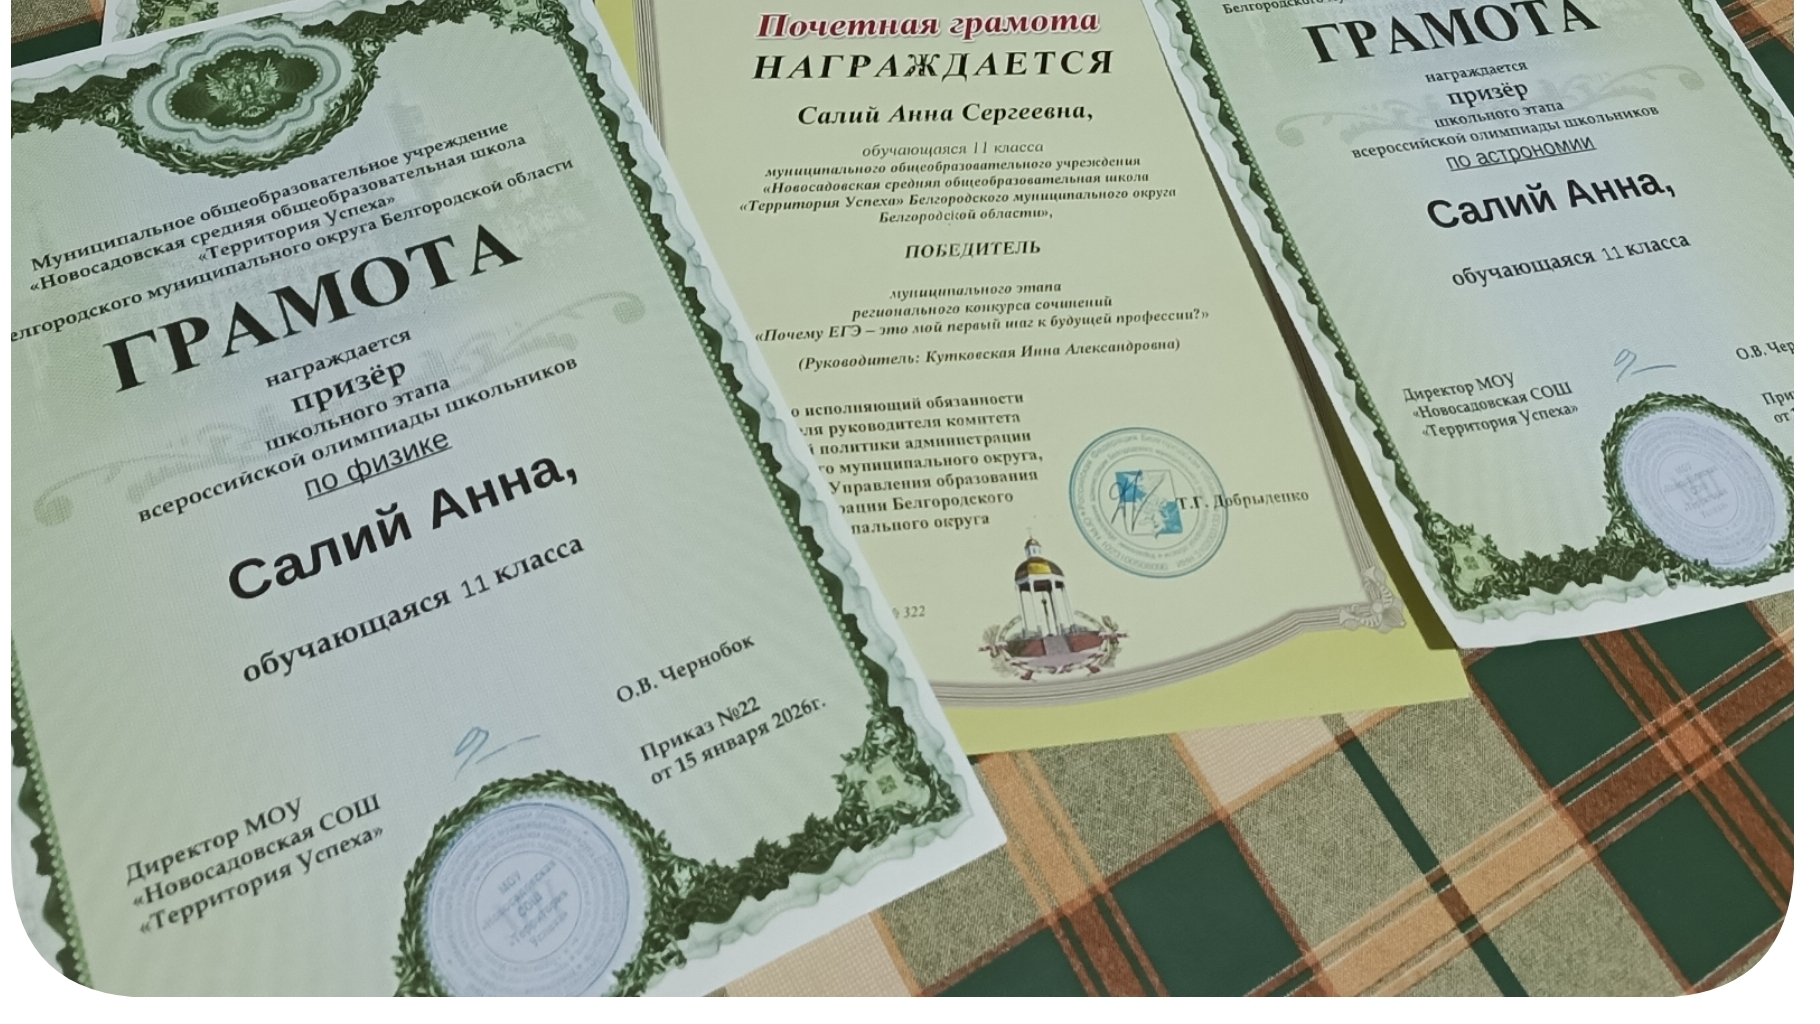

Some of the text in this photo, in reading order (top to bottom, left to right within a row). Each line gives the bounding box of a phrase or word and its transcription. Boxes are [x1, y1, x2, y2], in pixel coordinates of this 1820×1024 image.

[758, 14, 1097, 40] Почетная грамота
[753, 50, 1113, 82] НАГРАЖДАЕТСЯ
[1425, 62, 1528, 83] награждается
[1447, 82, 1528, 108] призёр
[798, 103, 1092, 125] Салий Анна Сергеевна,
[1434, 102, 1564, 128] школьного этапа
[1351, 107, 1659, 159] всероссийской олимпиады школьников
[862, 141, 1043, 159] обучающаяся 11 класса
[1445, 136, 1597, 172] по астрономии
[763, 174, 1148, 193] «Новосадовская средняя общеобразовательная школа
[765, 157, 1140, 179] муниципального общеобразовательного учреждения
[31, 123, 508, 271] Муниципальное общеобразовательное учреждение
[740, 189, 1176, 214] «Территория Успеха» Белгородского муниципального округа
[1427, 174, 1676, 228] Салий Анна,
[30, 137, 526, 291] «Новосадовская средняя общеобразовательная школа
[147, 241, 311, 299] муниципального
[316, 221, 377, 246] округа
[380, 181, 503, 226] Белгородской
[507, 160, 573, 187] области
[199, 197, 395, 261] «Территория Успеха»
[879, 209, 1052, 225] Белгородской области»,
[906, 241, 1040, 258] ПОБЕДИТЕЛЬ
[1452, 235, 1691, 287] обучающаяся 11 класса
[103, 224, 523, 393] ГРАМОТА
[889, 283, 1061, 302] муниципального этапа
[755, 308, 1209, 342] «Почему ЕГЭ это мой первый шаг к будущей профессии?»
[852, 296, 1112, 322] регионального конкурса сочинений
[265, 330, 411, 387] награждается
[799, 340, 1180, 372] (Руководитель: Кутковская Инна Александровна)
[1736, 344, 1768, 361] О.В.
[291, 362, 405, 414] призёр
[1403, 374, 1514, 402] Директор МОУ
[1413, 382, 1573, 418] «Новосадовская СОШ
[265, 379, 450, 451] школьного этапа
[805, 398, 921, 416] исполняющий
[926, 394, 1023, 408] обязанности
[1774, 412, 1791, 424] от
[829, 418, 941, 438] руководителя
[946, 414, 1020, 427] комитета
[1422, 405, 1578, 438] «Территория Успеха»
[139, 359, 577, 522] всероссийской олимпиады школьников
[820, 441, 900, 455] политики
[905, 433, 1031, 449] администрации
[304, 432, 453, 500] по физике
[840, 456, 978, 476] муниципального
[983, 452, 1043, 466] округа,
[829, 472, 1038, 496] Управления образования
[893, 494, 1013, 511] Белгородского
[1176, 496, 1210, 511] Т.Г.
[229, 458, 577, 599] Салий Анна,
[244, 539, 584, 682] обучающаяся 11 класса
[903, 604, 926, 619] 322
[617, 636, 755, 702] О.В. Чернобок
[640, 697, 761, 761] Приказ №22
[651, 699, 826, 784] от 15 января 2026г.
[127, 797, 300, 886] Директор МОУ
[134, 794, 380, 905] «Новосадовская СОШ
[141, 828, 383, 932] «Территория Успеха»
